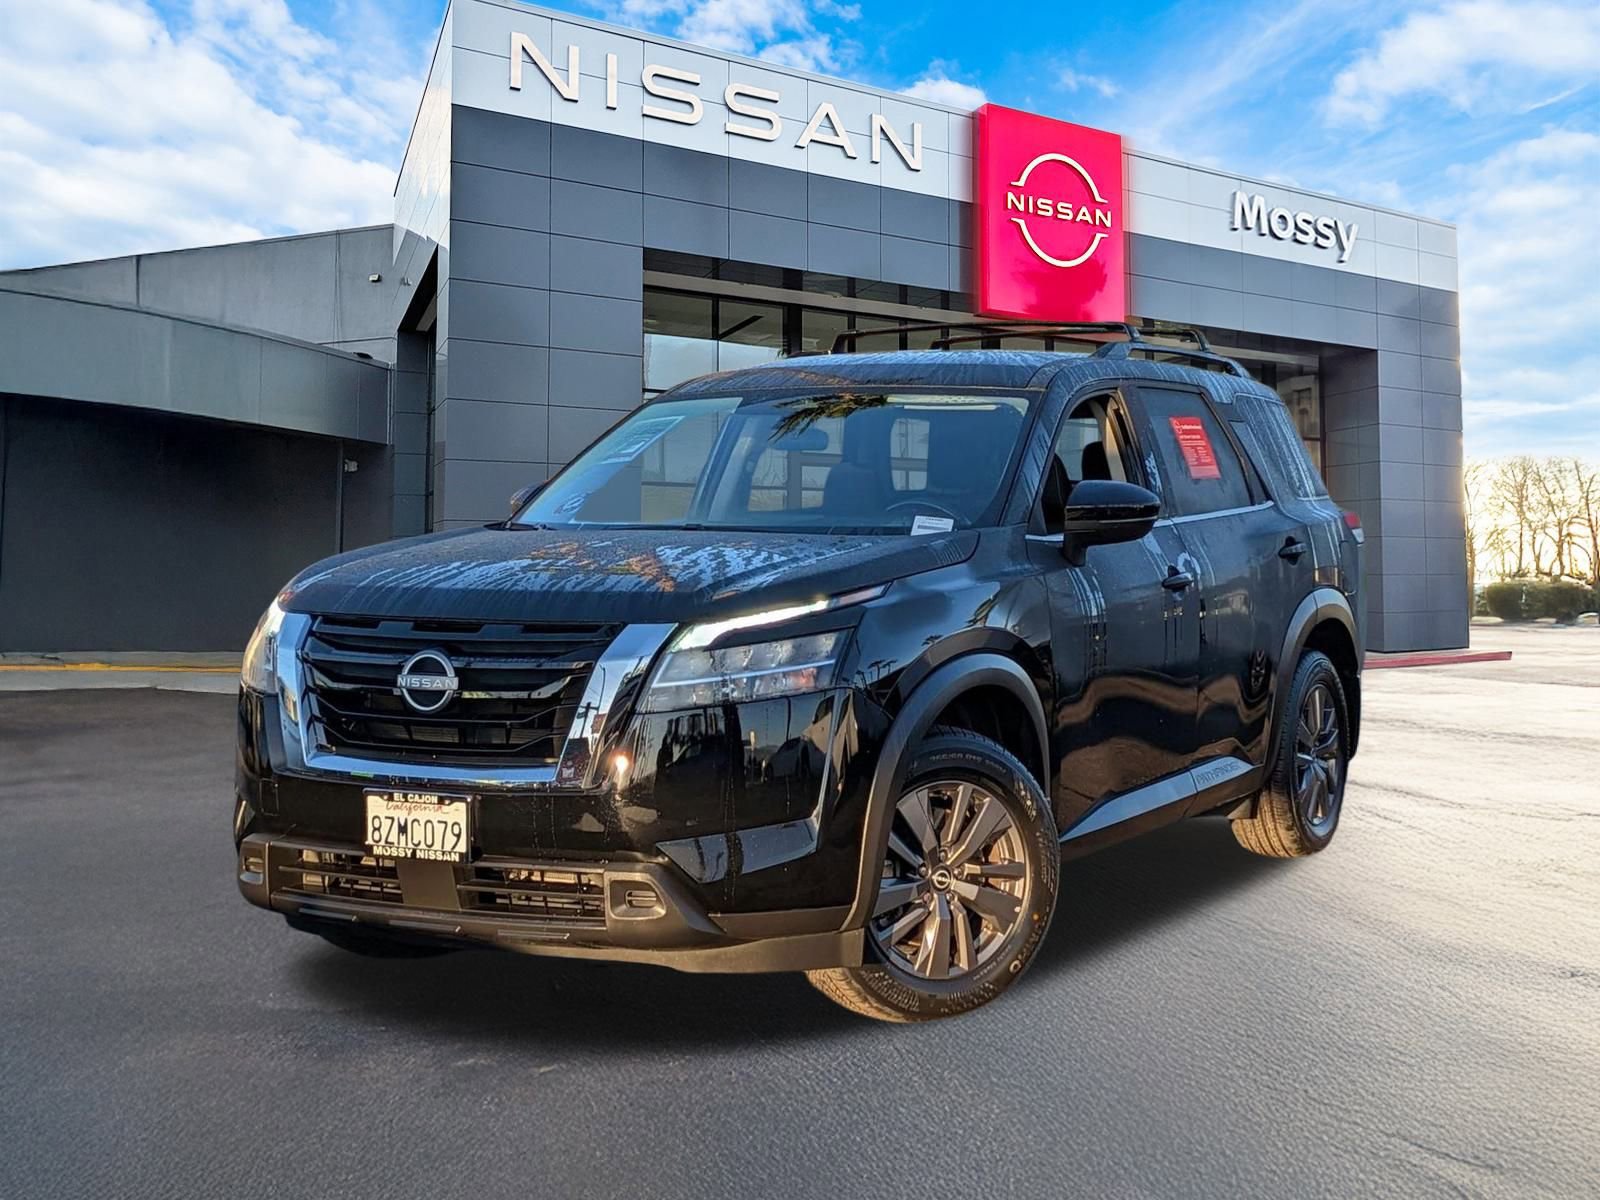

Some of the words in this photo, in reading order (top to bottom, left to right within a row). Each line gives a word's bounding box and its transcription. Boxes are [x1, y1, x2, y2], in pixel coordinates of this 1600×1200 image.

[508, 31, 922, 172] NISSAN
[1007, 191, 1112, 228] NISSAN
[1231, 190, 1360, 263] Mossy
[399, 676, 456, 689] NISSAN
[393, 793, 405, 801] EL
[407, 794, 438, 804] CAJON
[372, 815, 462, 850] 8ZMC079
[373, 845, 413, 858] MOSSY
[416, 850, 460, 862] NISSAN
